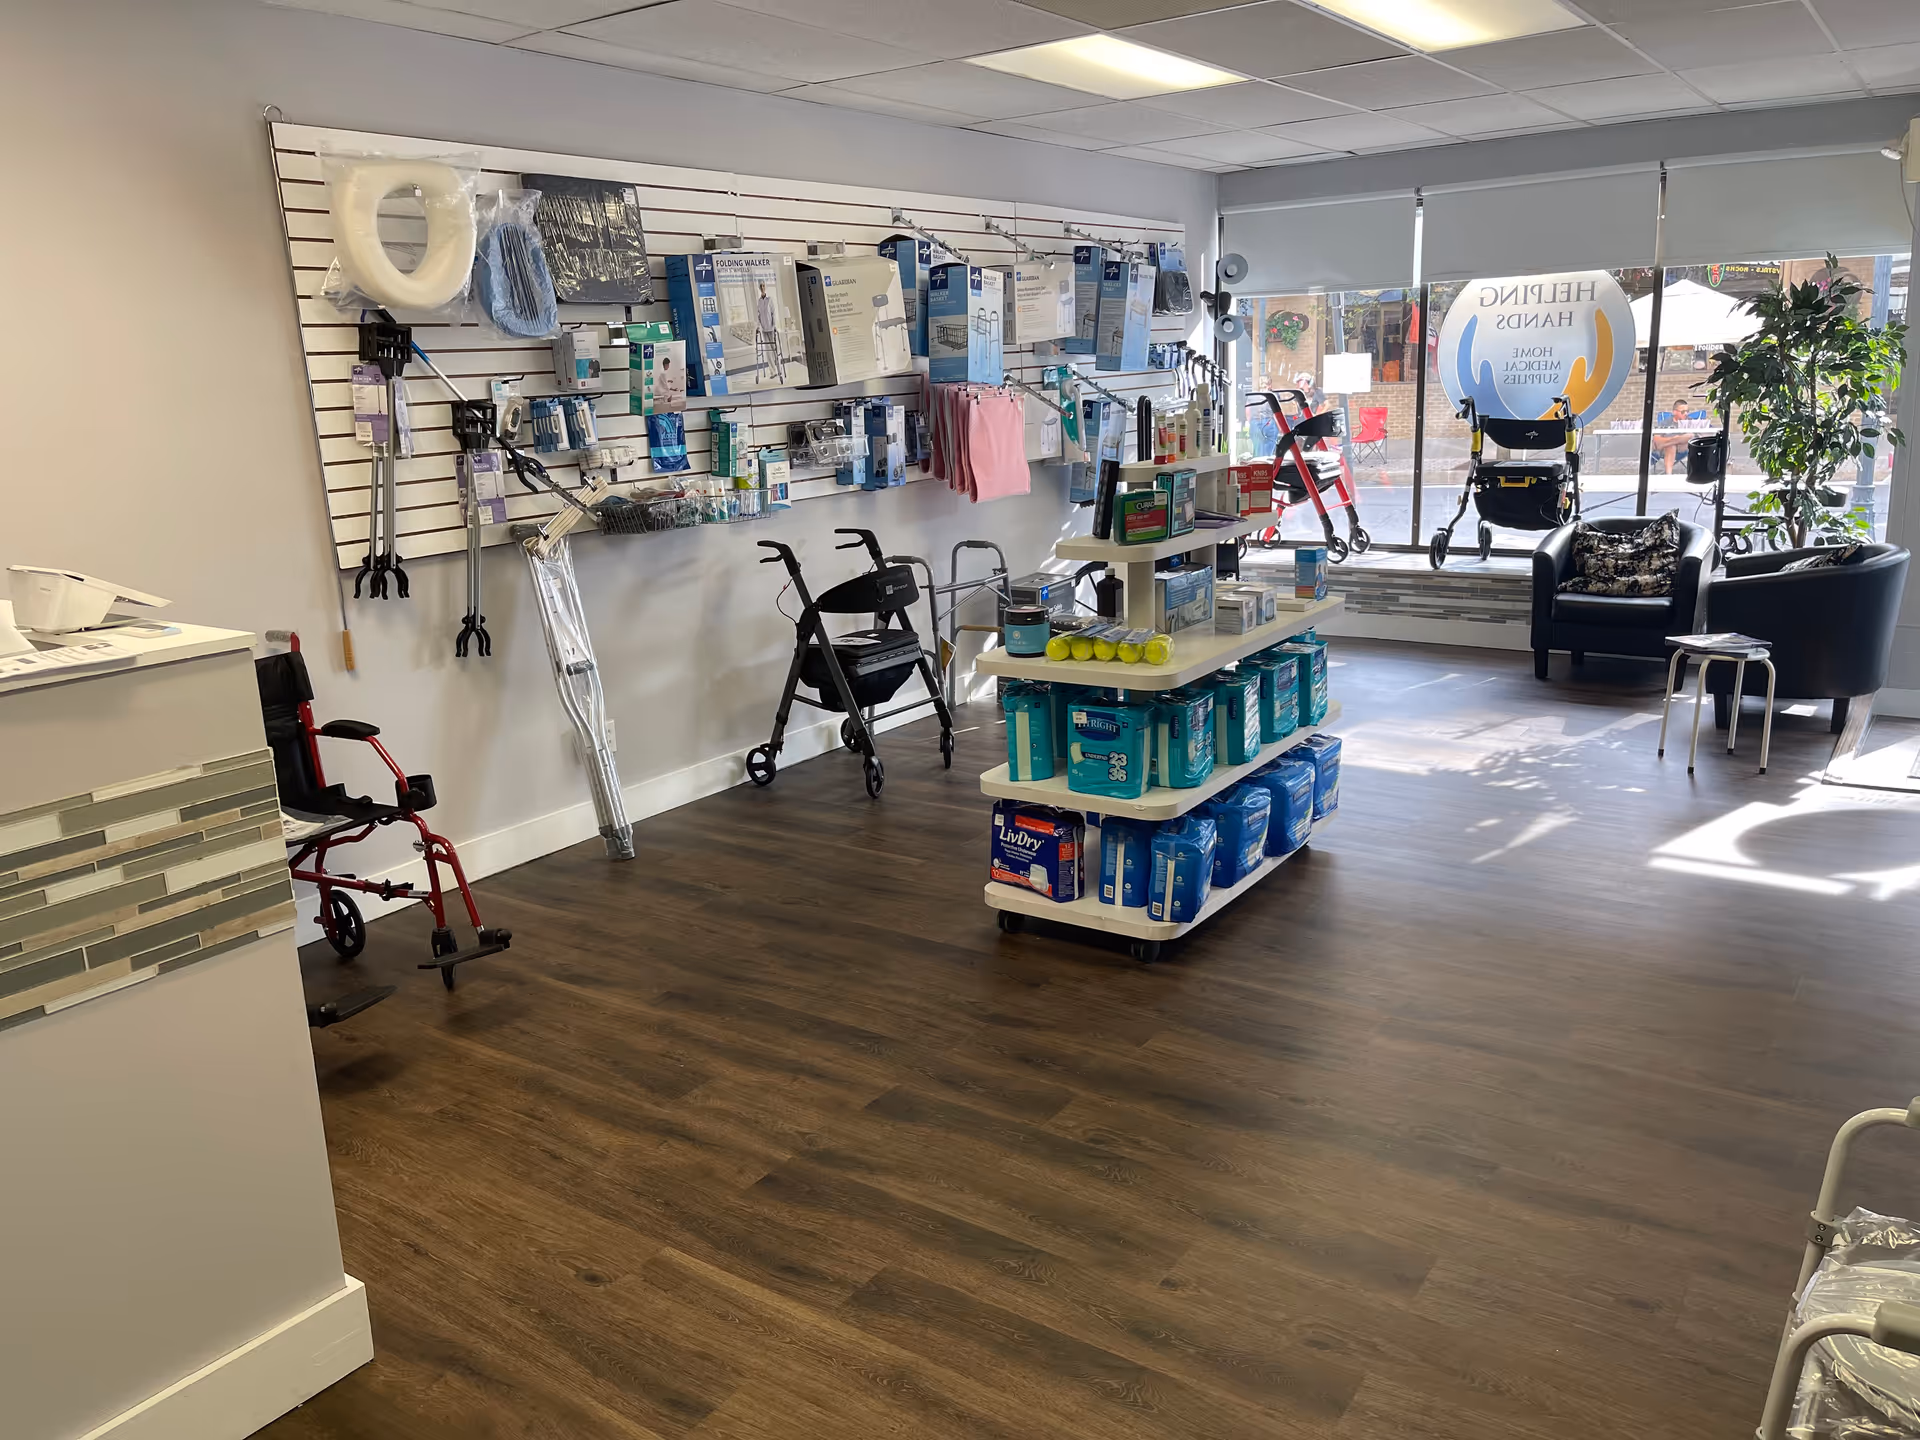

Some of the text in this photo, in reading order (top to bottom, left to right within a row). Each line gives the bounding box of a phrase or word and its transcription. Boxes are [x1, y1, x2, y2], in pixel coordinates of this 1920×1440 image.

[715, 258, 771, 268] FOLDING WALKER
[832, 278, 857, 286] GUARDIAN
[1694, 343, 1724, 351] Trollbea
[1109, 751, 1127, 766] 23
[1108, 767, 1127, 782] 36
[999, 825, 1042, 851] LivDry
[992, 869, 1000, 878] 12
